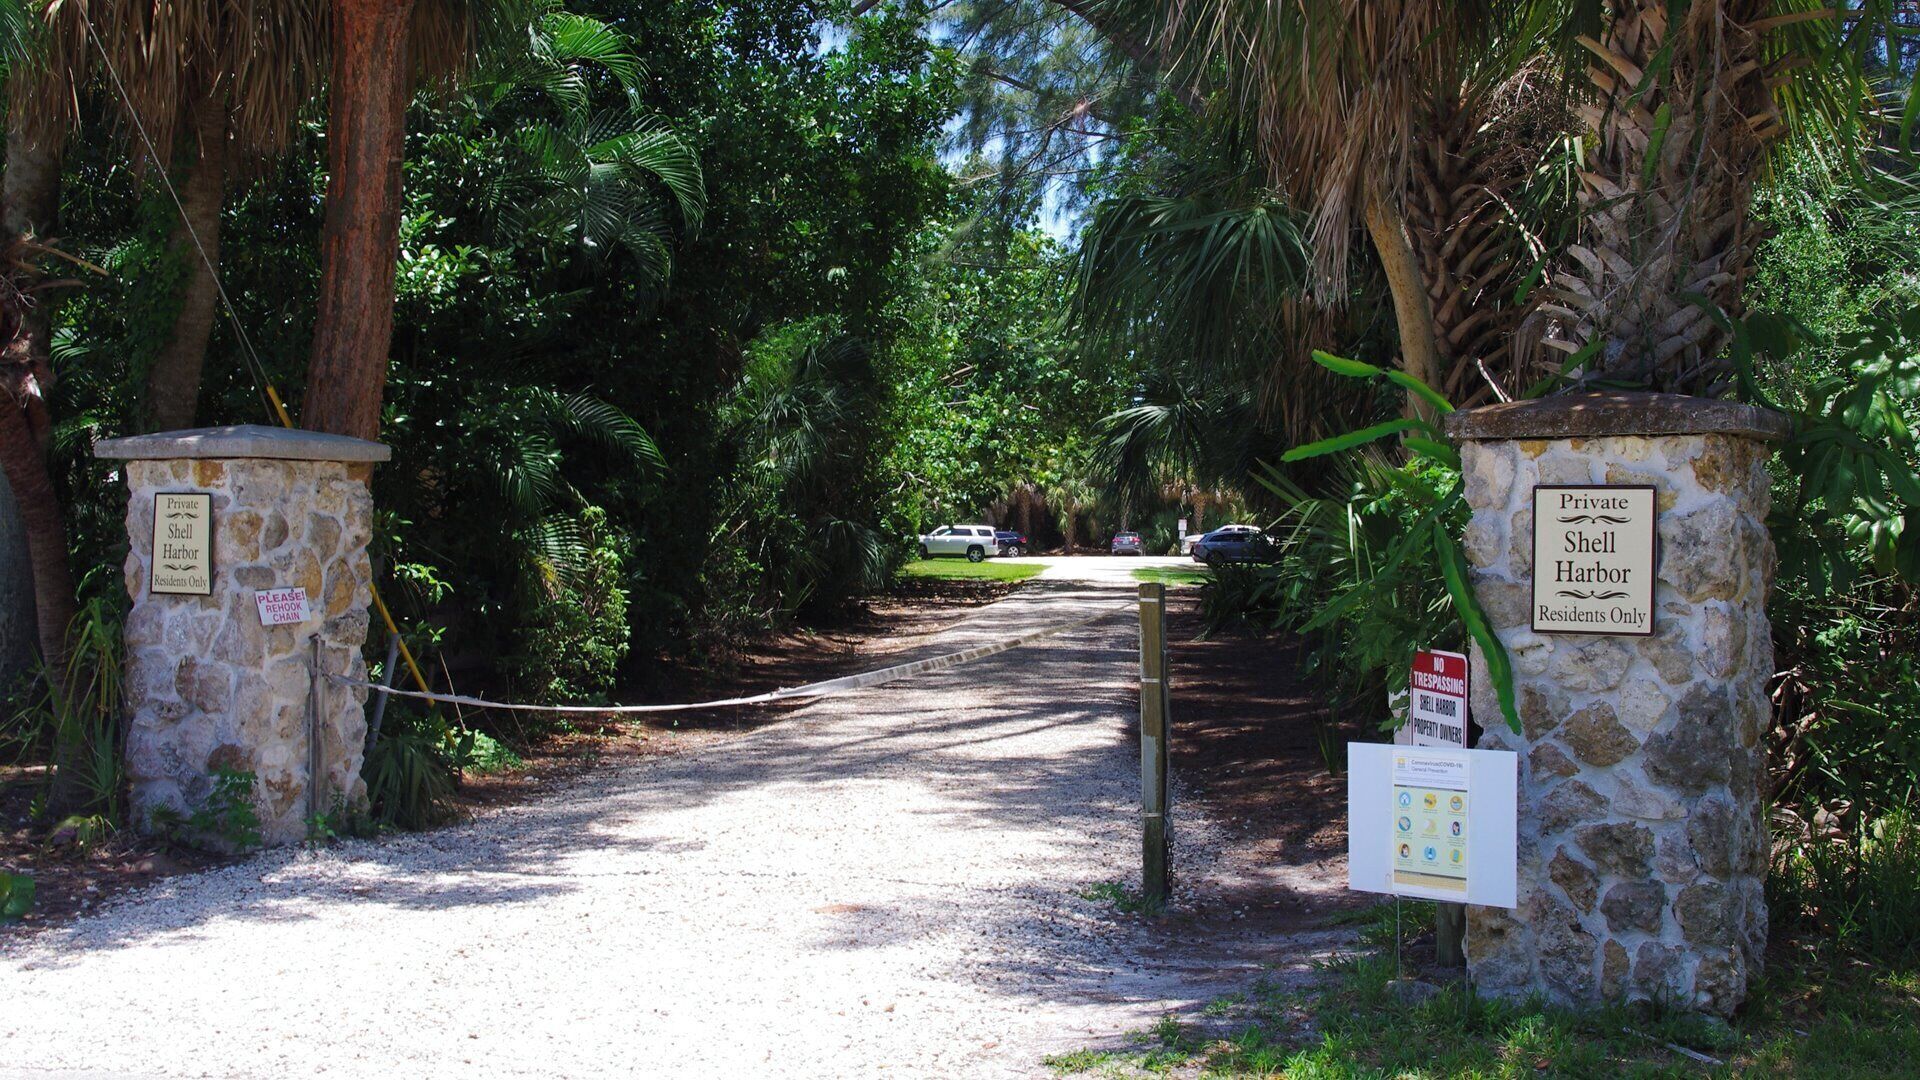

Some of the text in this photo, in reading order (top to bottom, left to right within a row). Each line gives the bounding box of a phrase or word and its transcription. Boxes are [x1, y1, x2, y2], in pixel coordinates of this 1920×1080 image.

[167, 498, 199, 510] Private
[1560, 493, 1628, 510] Private
[168, 523, 193, 540] Shell
[1564, 530, 1616, 553] Shell
[163, 543, 199, 560] Harbor
[1555, 560, 1631, 584] Harbor
[154, 574, 208, 590] Residents Only
[258, 590, 306, 604] PLEASE!
[265, 602, 303, 614] REHOOK
[1539, 604, 1646, 628] Residents Only
[273, 612, 300, 623] CHAIN
[1433, 656, 1445, 674] NO
[1414, 670, 1464, 695] TRESPASSING
[1420, 694, 1457, 717] SHELL HARBOR
[1414, 717, 1463, 745] PROPERTY OWNERS
